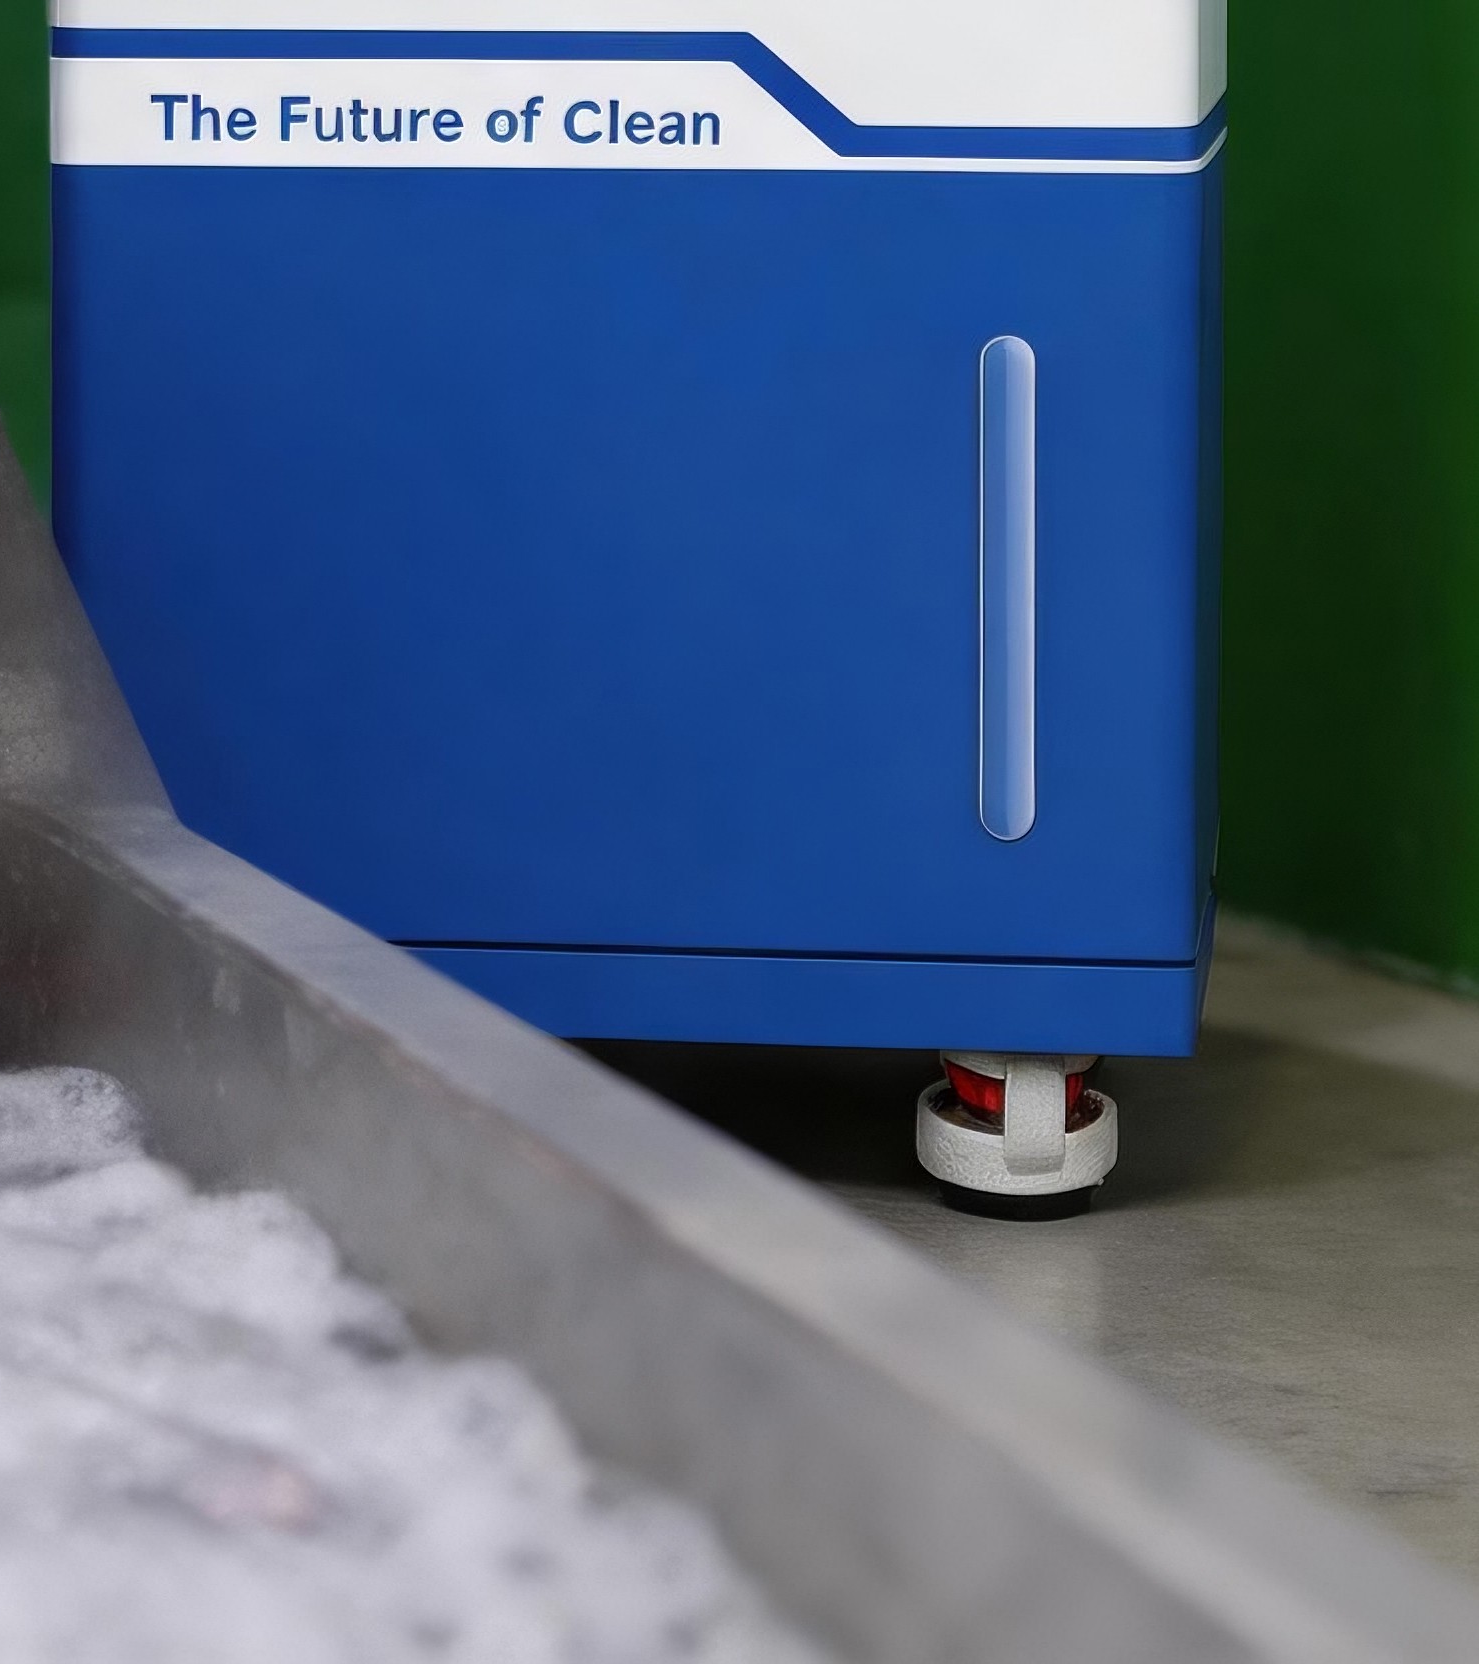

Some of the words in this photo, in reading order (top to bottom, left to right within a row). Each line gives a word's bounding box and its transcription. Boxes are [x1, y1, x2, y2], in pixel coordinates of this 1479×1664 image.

[151, 94, 256, 142] The
[281, 96, 463, 143] Future
[486, 96, 544, 143] of
[564, 100, 720, 145] Clean
